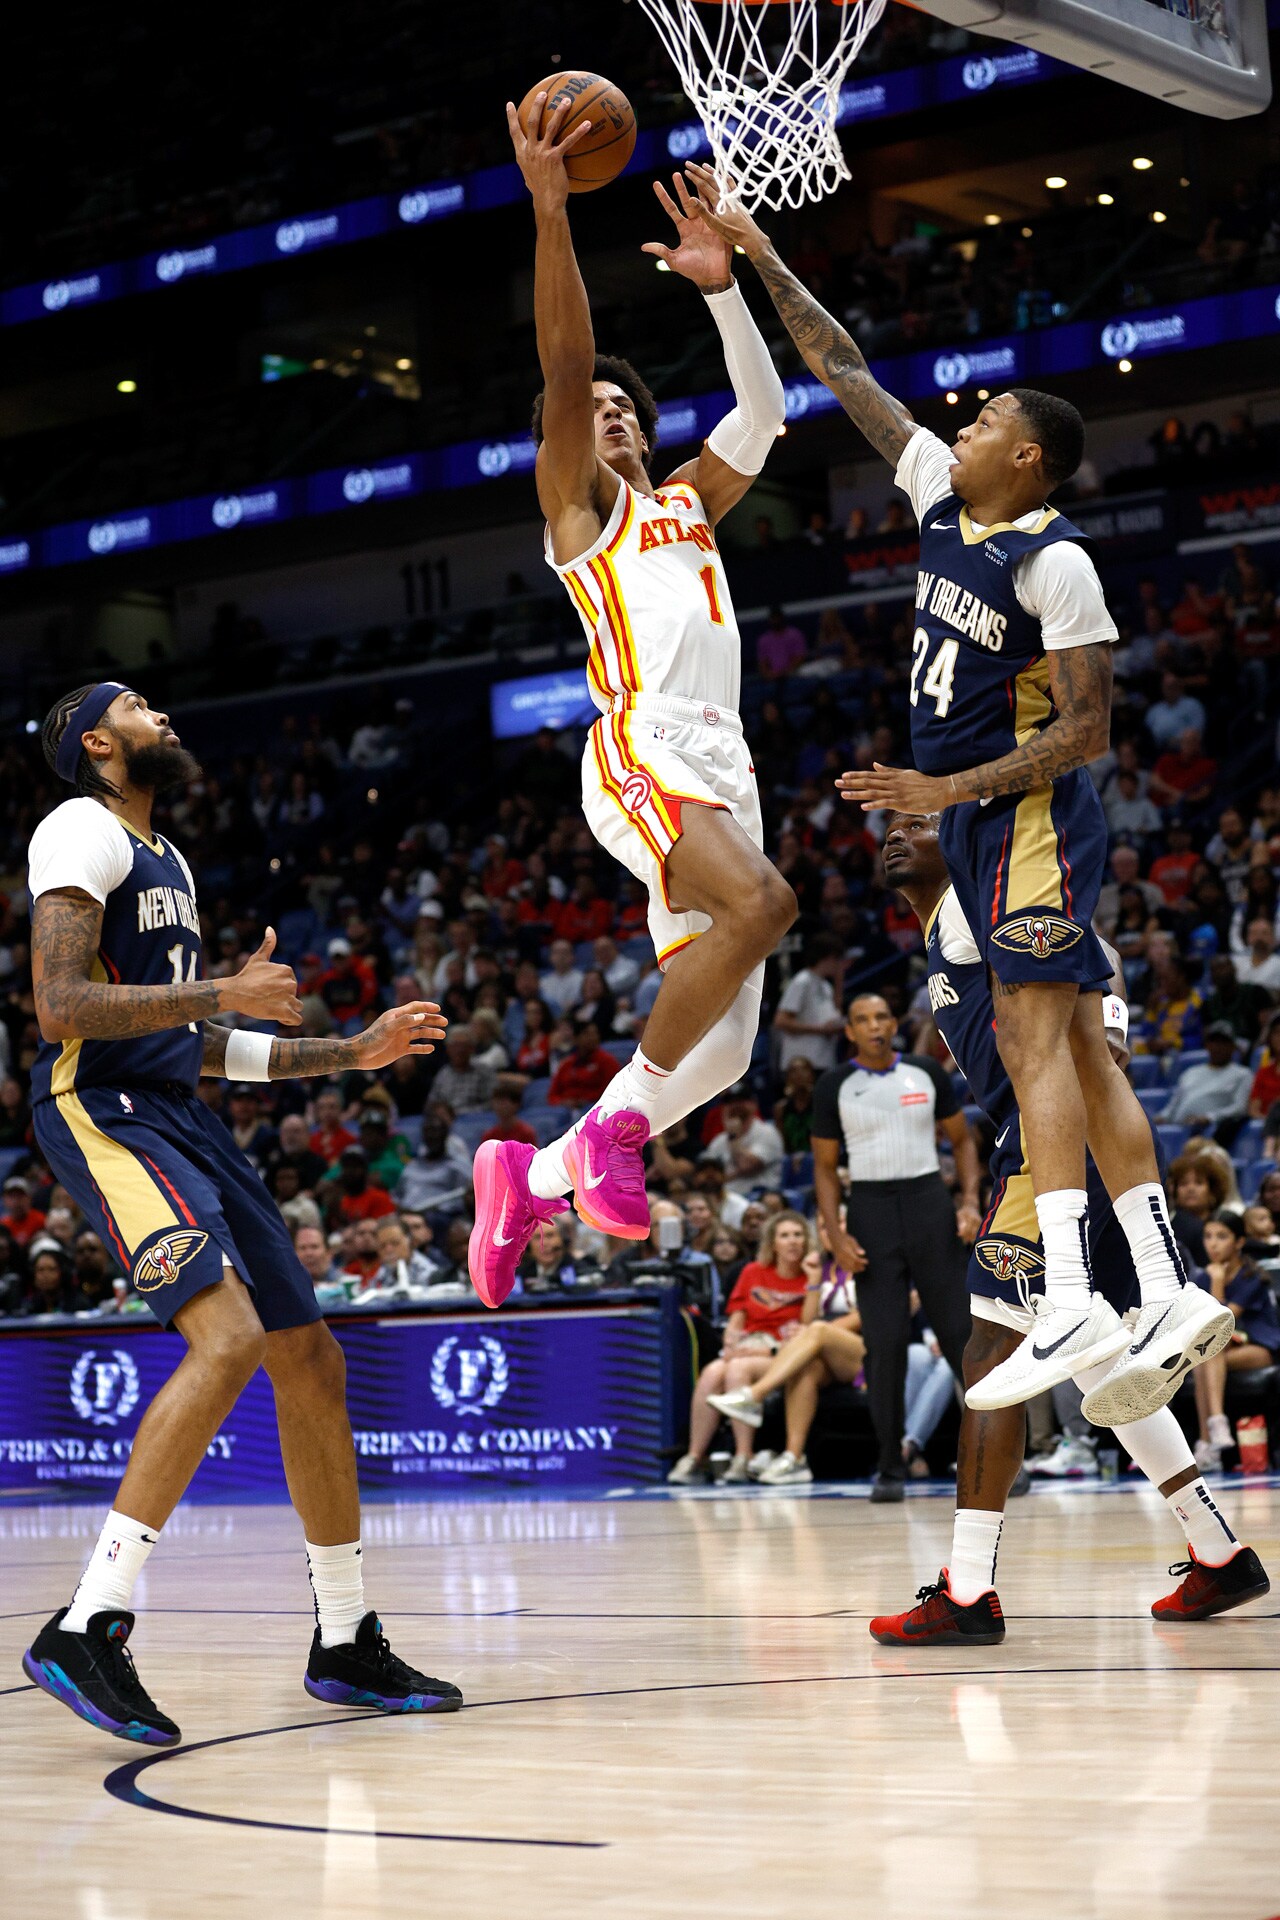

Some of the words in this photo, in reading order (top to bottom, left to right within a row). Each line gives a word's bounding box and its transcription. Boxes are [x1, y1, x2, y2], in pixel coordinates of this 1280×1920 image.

[984, 540, 1009, 562] NEWAGE
[984, 551, 1004, 567] GARAGE
[698, 564, 725, 626] 1
[929, 576, 1008, 652] ORLEANS
[909, 626, 960, 719] 24
[137, 886, 178, 933] NEW
[88, 1438, 109, 1461] &
[451, 1431, 474, 1453] &
[478, 1426, 619, 1452] COMPANY
